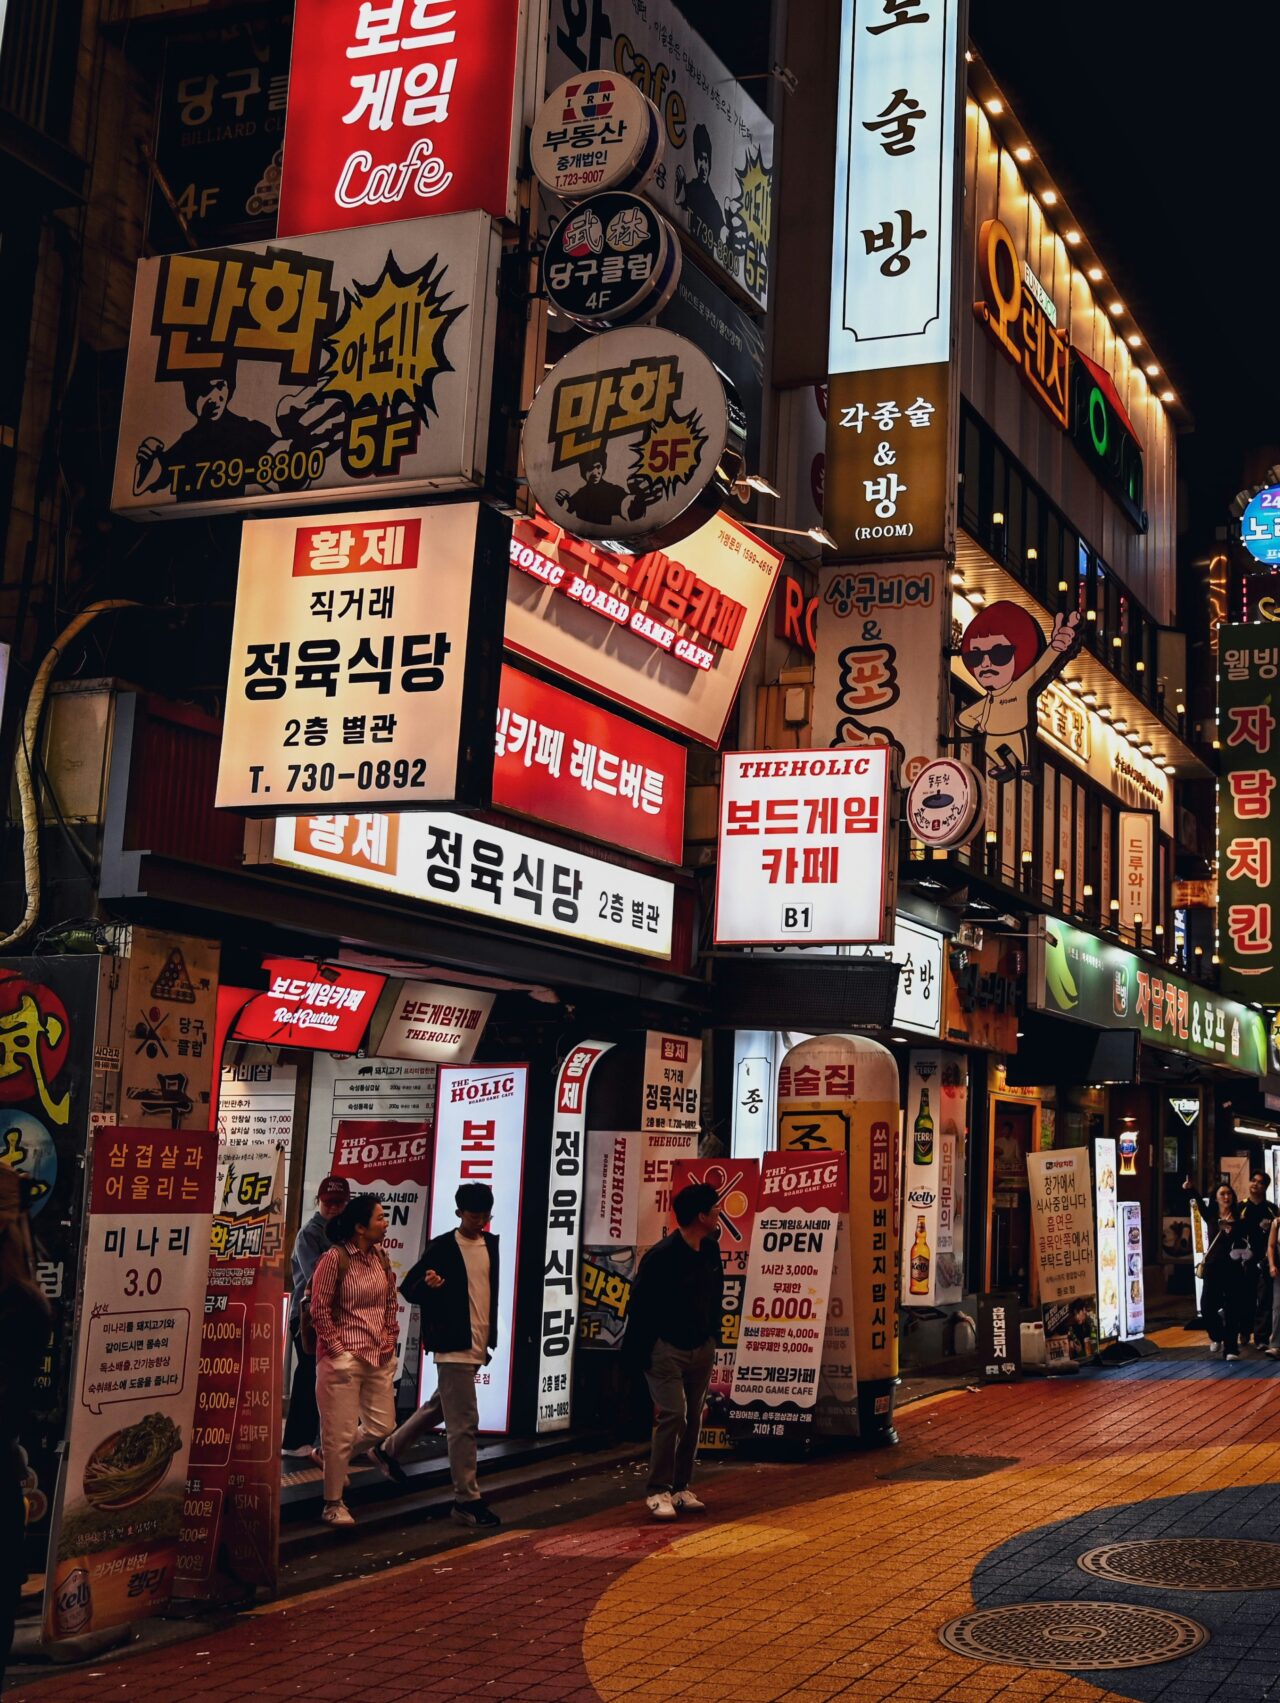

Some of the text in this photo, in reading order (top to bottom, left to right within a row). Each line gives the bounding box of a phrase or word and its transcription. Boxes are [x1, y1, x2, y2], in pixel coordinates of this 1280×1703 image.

[346, 0, 458, 59] 보드
[342, 58, 458, 131] 게임
[181, 121, 257, 147] BILLIARD
[543, 120, 628, 152] 부동산
[335, 138, 453, 209] Cafe
[556, 150, 608, 172] 중개법인
[555, 169, 605, 189] T.723-9007
[178, 182, 221, 220] 4F
[549, 252, 652, 291] 당구클럽
[160, 253, 330, 375] 만화
[585, 290, 613, 310] 4F
[555, 362, 676, 463] 만화
[839, 397, 936, 434] 각종술
[347, 414, 415, 470] 5F
[647, 437, 692, 474] 5F
[873, 441, 897, 467] &
[168, 449, 325, 496] T.739-8800
[862, 473, 908, 520] 방
[854, 523, 914, 541] (ROOM)
[308, 525, 406, 571] 황제
[309, 585, 395, 622] 직거래
[830, 577, 932, 616] 상구비어
[567, 574, 631, 625] BOARD
[629, 610, 675, 656] GAME
[673, 635, 715, 672] CAFE
[861, 622, 883, 641] &
[243, 631, 452, 701] 정육식당
[1223, 648, 1280, 681] 웰빙
[283, 713, 398, 748] 2층 별관
[285, 757, 428, 794] 730-0892
[568, 739, 665, 816] 레드버튼
[739, 757, 871, 779] THEHOLIC
[726, 796, 880, 837] 보드게임
[1226, 704, 1276, 954] 자담치킨
[425, 826, 583, 924] 정육식당
[761, 847, 840, 886] 카페
[1127, 838, 1145, 907] 드루와!!
[599, 889, 661, 934] 2층 별관
[783, 907, 811, 929] B1
[899, 952, 935, 1001] 술방
[267, 976, 367, 1013] 보드게임카페
[1135, 970, 1189, 1040] 자담치킨
[1191, 1001, 1202, 1043] &
[179, 1016, 205, 1035] 당구
[399, 1000, 483, 1031] 보드게임카페
[404, 1028, 462, 1045] THEHOLIC
[664, 1041, 685, 1060] 황제
[374, 1066, 402, 1076] 돼지고기
[451, 1078, 470, 1089] THE
[560, 1050, 591, 1109] 황제
[663, 1068, 684, 1084] 직거래
[450, 1077, 515, 1104] HOLIC
[646, 1083, 698, 1113] 정육식당
[268, 1127, 291, 1135] 17,000
[269, 1115, 292, 1124] 17,000
[107, 1142, 204, 1169] 삼겹살과
[338, 1138, 427, 1166] HOLIC
[342, 1137, 367, 1149] THE
[648, 1135, 692, 1148] THEHOLIC
[765, 1166, 787, 1177] THE
[871, 1128, 889, 1196] 쓰레기
[104, 1174, 201, 1200] 어울리는
[239, 1173, 269, 1204] 5F
[609, 1137, 626, 1239] THEHOLIC
[762, 1164, 839, 1195] HOLIC
[1044, 1173, 1076, 1197] 창가에서
[907, 1190, 937, 1208] Kelly
[1036, 1194, 1087, 1214] 식사중입니다
[759, 1219, 831, 1231] 보드게임&시네마
[1046, 1213, 1073, 1233] 흡연은
[103, 1225, 191, 1258] 미나리
[543, 1130, 581, 1359] 정육식당
[762, 1231, 823, 1253] OPEN
[871, 1208, 888, 1276] 버리지
[1039, 1232, 1090, 1254] 골목안쪽에서
[761, 1264, 784, 1276] 1시간
[1040, 1251, 1094, 1271] 부탁드립니다!
[123, 1267, 162, 1297] 3.0
[580, 1265, 631, 1317] 만화
[773, 1282, 801, 1294] 무제한
[102, 1318, 176, 1334] 미나리를 돼지고기와
[870, 1285, 887, 1352] 맙시다
[992, 1306, 1007, 1359] 흡연금지
[105, 1340, 144, 1353] 같이드시면
[87, 1374, 178, 1394] 숙취해소에 도움을 줍니다
[734, 1384, 814, 1396] BOARD GAME CAFE
[736, 1366, 816, 1384] 보드게임카페
[539, 1400, 570, 1420] T.730-0892
[127, 1566, 167, 1598] 켈리
